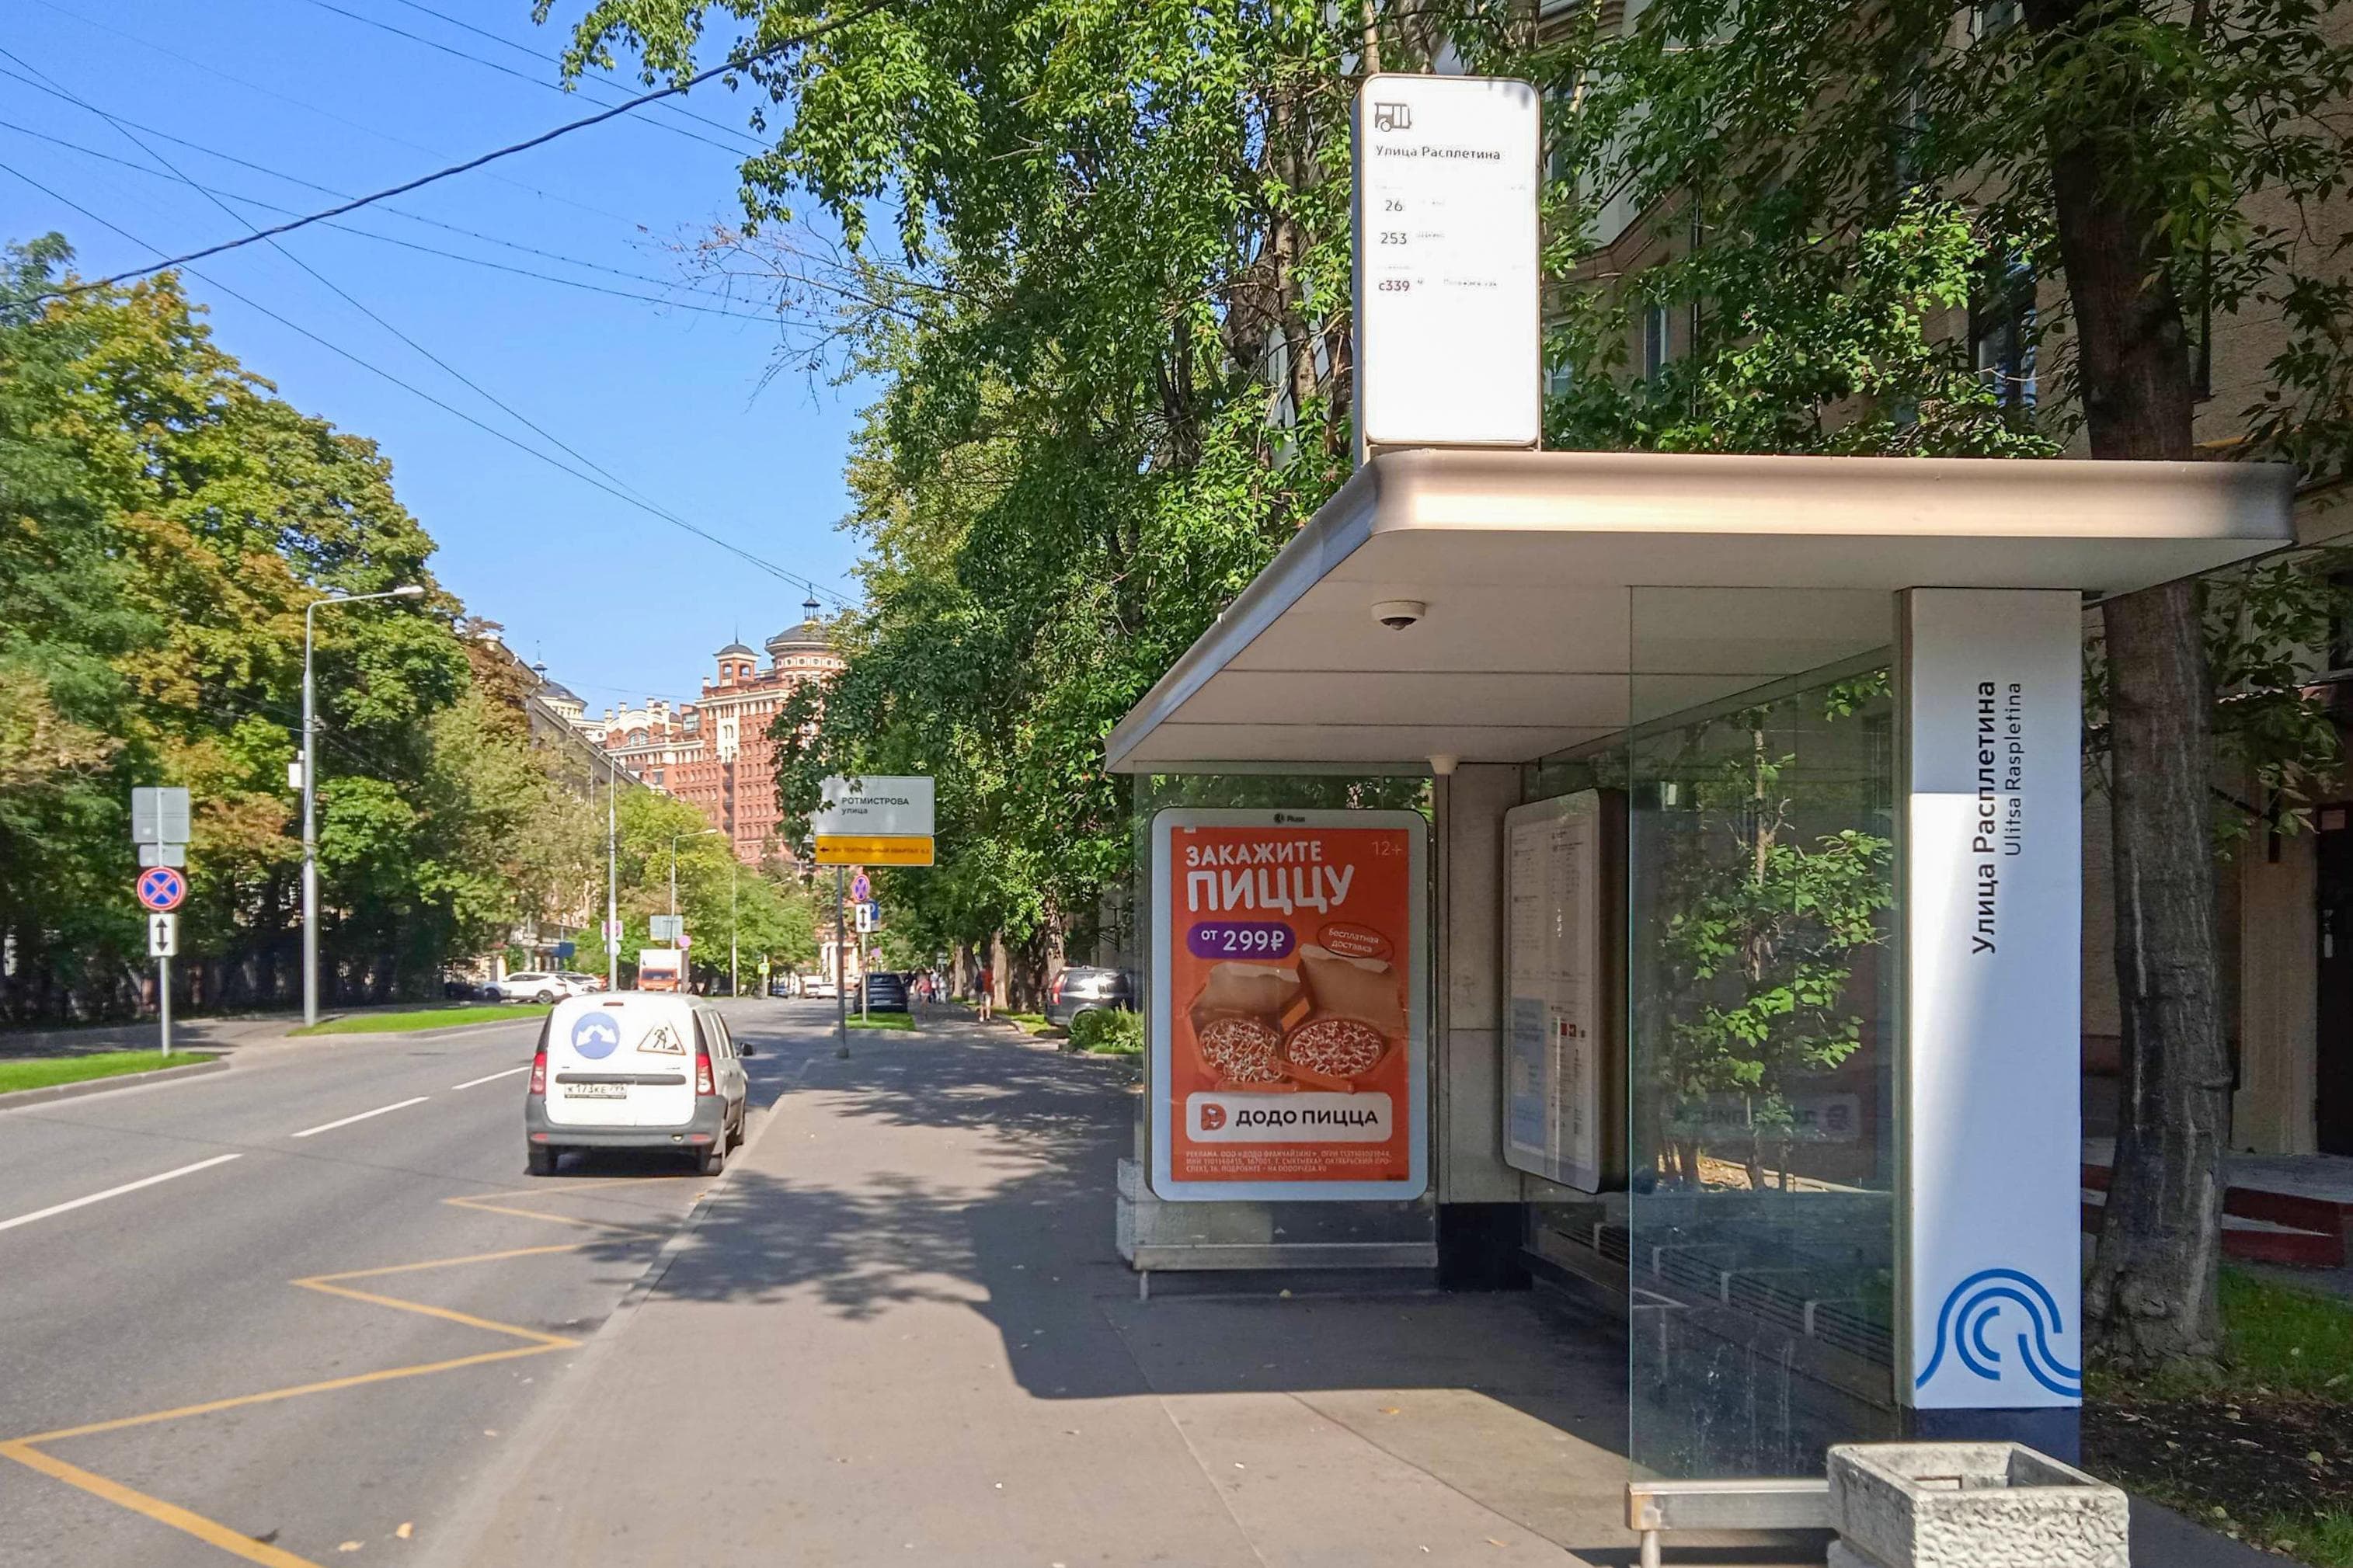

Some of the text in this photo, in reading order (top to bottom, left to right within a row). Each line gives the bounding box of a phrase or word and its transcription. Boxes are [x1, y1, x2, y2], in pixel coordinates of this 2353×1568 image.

[1376, 144, 1502, 160] Улица Расплетина
[1384, 199, 1404, 212] 26
[1380, 231, 1408, 245] 253
[1378, 280, 1411, 291] с339
[2004, 682, 2025, 856] Ulitsa Raspletina
[841, 797, 910, 805] РОТМИСТРОВА
[1972, 680, 1999, 954] Улица Расплетина
[1185, 840, 1322, 867] ЗАКАЖИТЕ
[1372, 840, 1403, 857] 12+
[1186, 864, 1356, 916] ПИЦЦУ
[1223, 930, 1286, 952] 299₽
[1236, 1110, 1378, 1128] ДОДО ПИЦЦА
